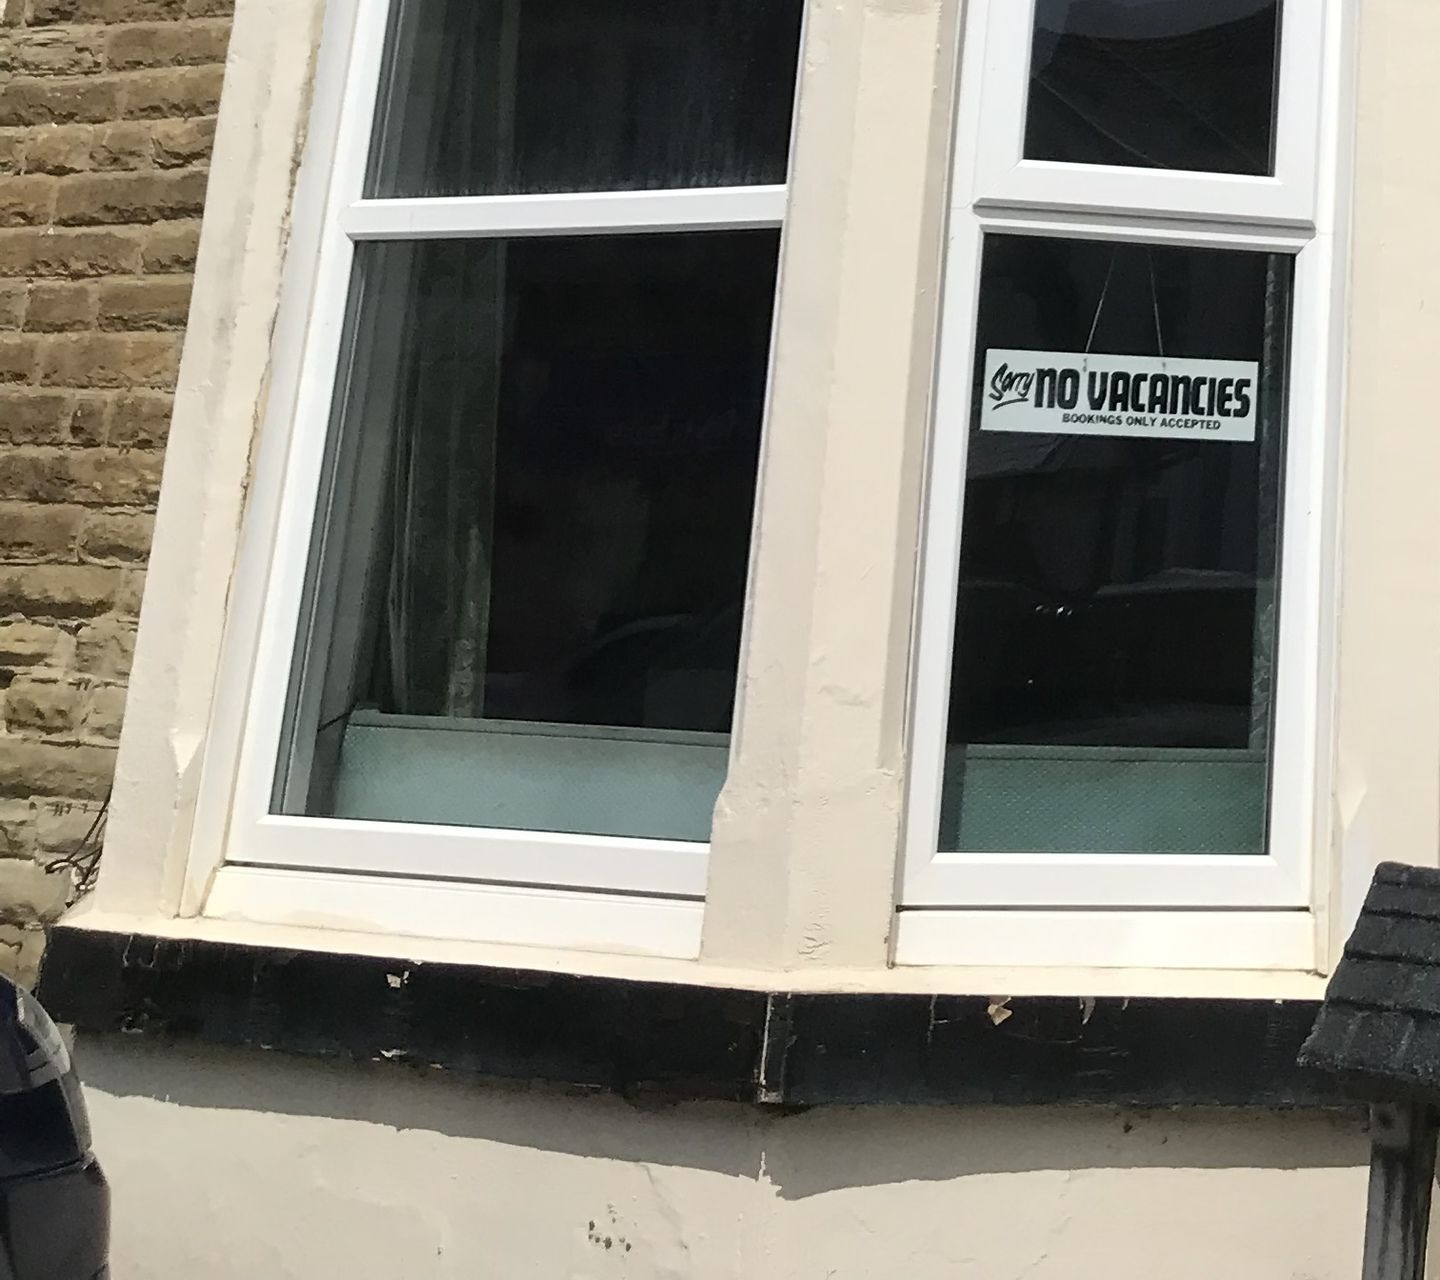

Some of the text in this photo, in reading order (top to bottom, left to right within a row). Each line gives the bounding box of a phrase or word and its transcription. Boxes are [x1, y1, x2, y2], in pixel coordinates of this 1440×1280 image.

[988, 362, 1252, 419] Sorry NO VACANCIES
[1062, 413, 1222, 430] BOOKINGS ONLY ACCEPTED
